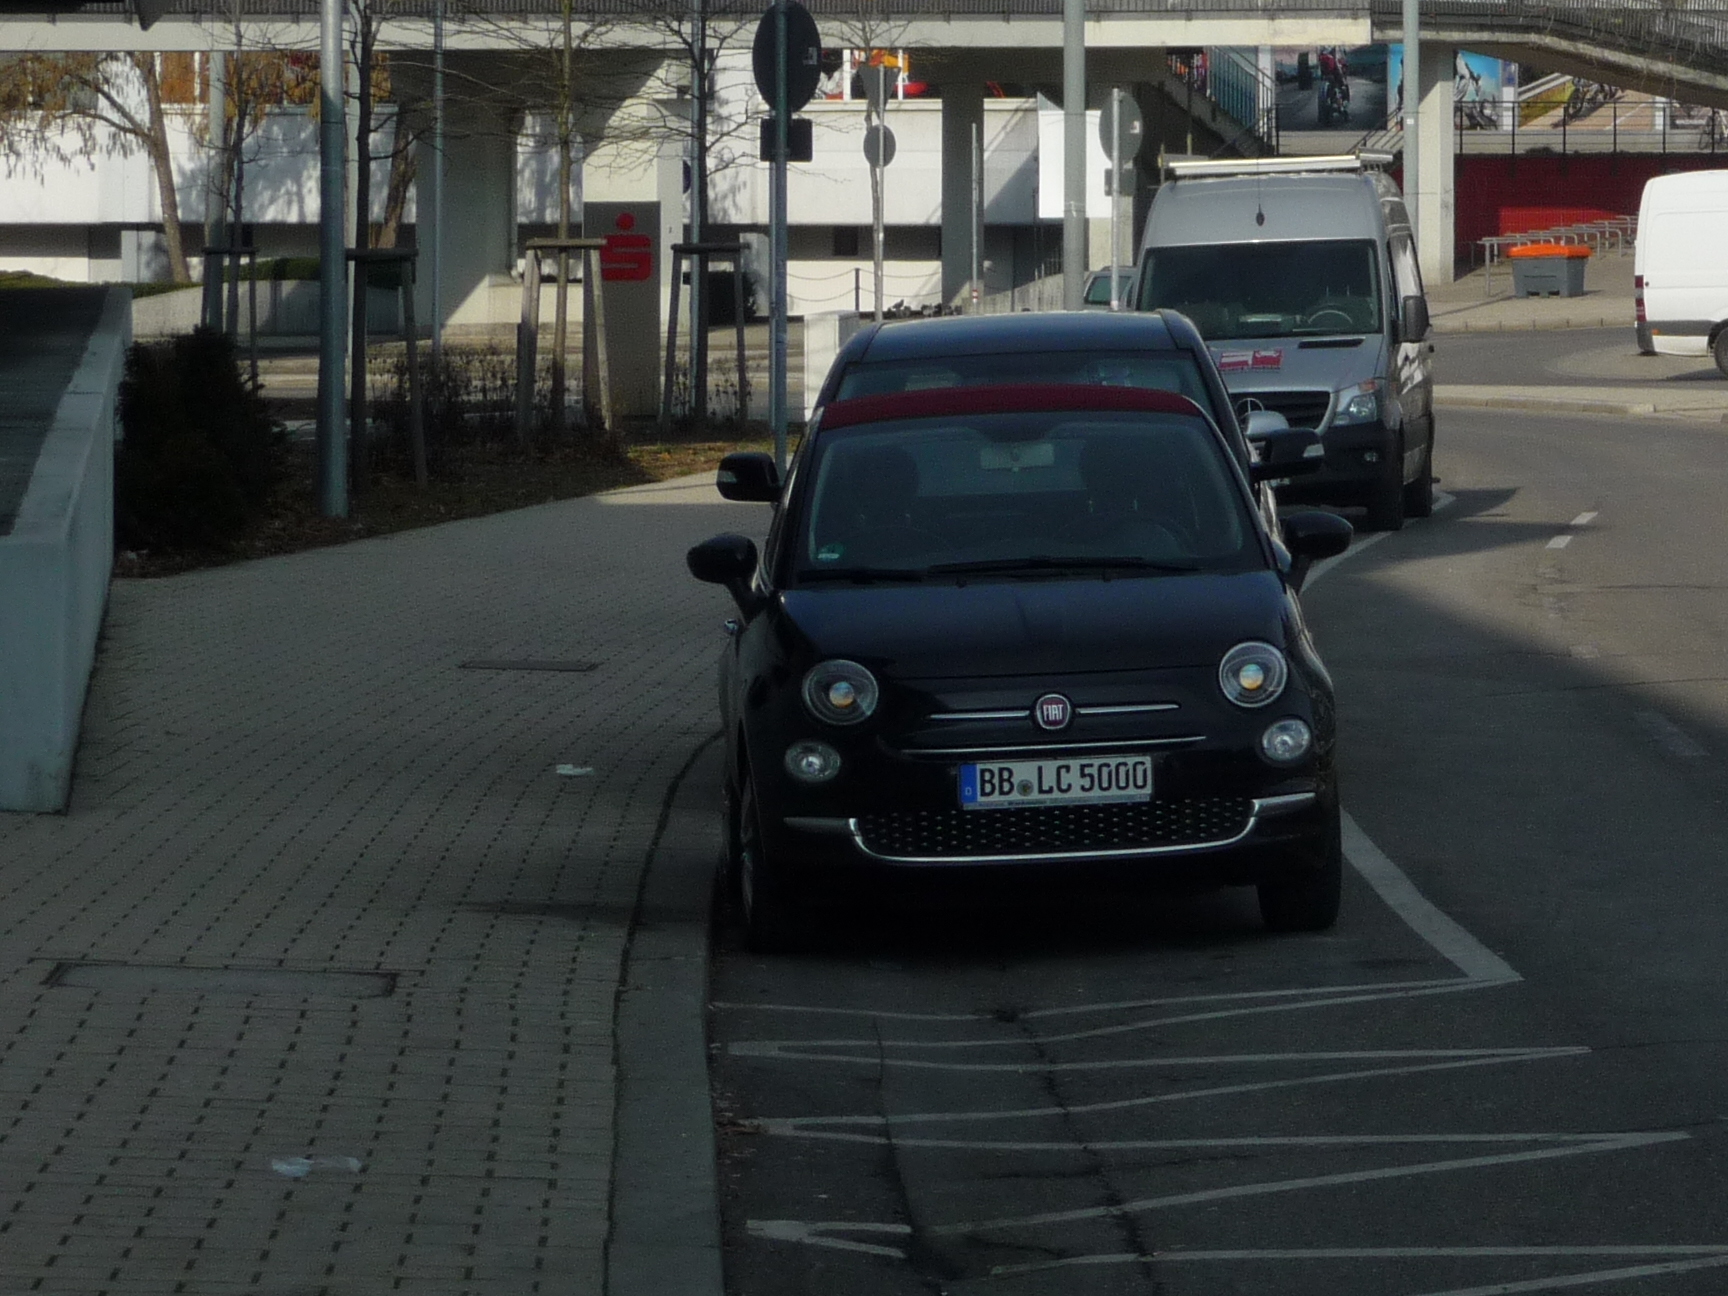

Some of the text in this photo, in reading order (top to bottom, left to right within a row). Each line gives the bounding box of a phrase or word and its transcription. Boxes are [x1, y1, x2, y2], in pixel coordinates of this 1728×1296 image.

[1043, 704, 1064, 721] FIAT
[979, 767, 1015, 797] BB
[1038, 764, 1072, 795] LC
[1079, 760, 1149, 793] 5000
